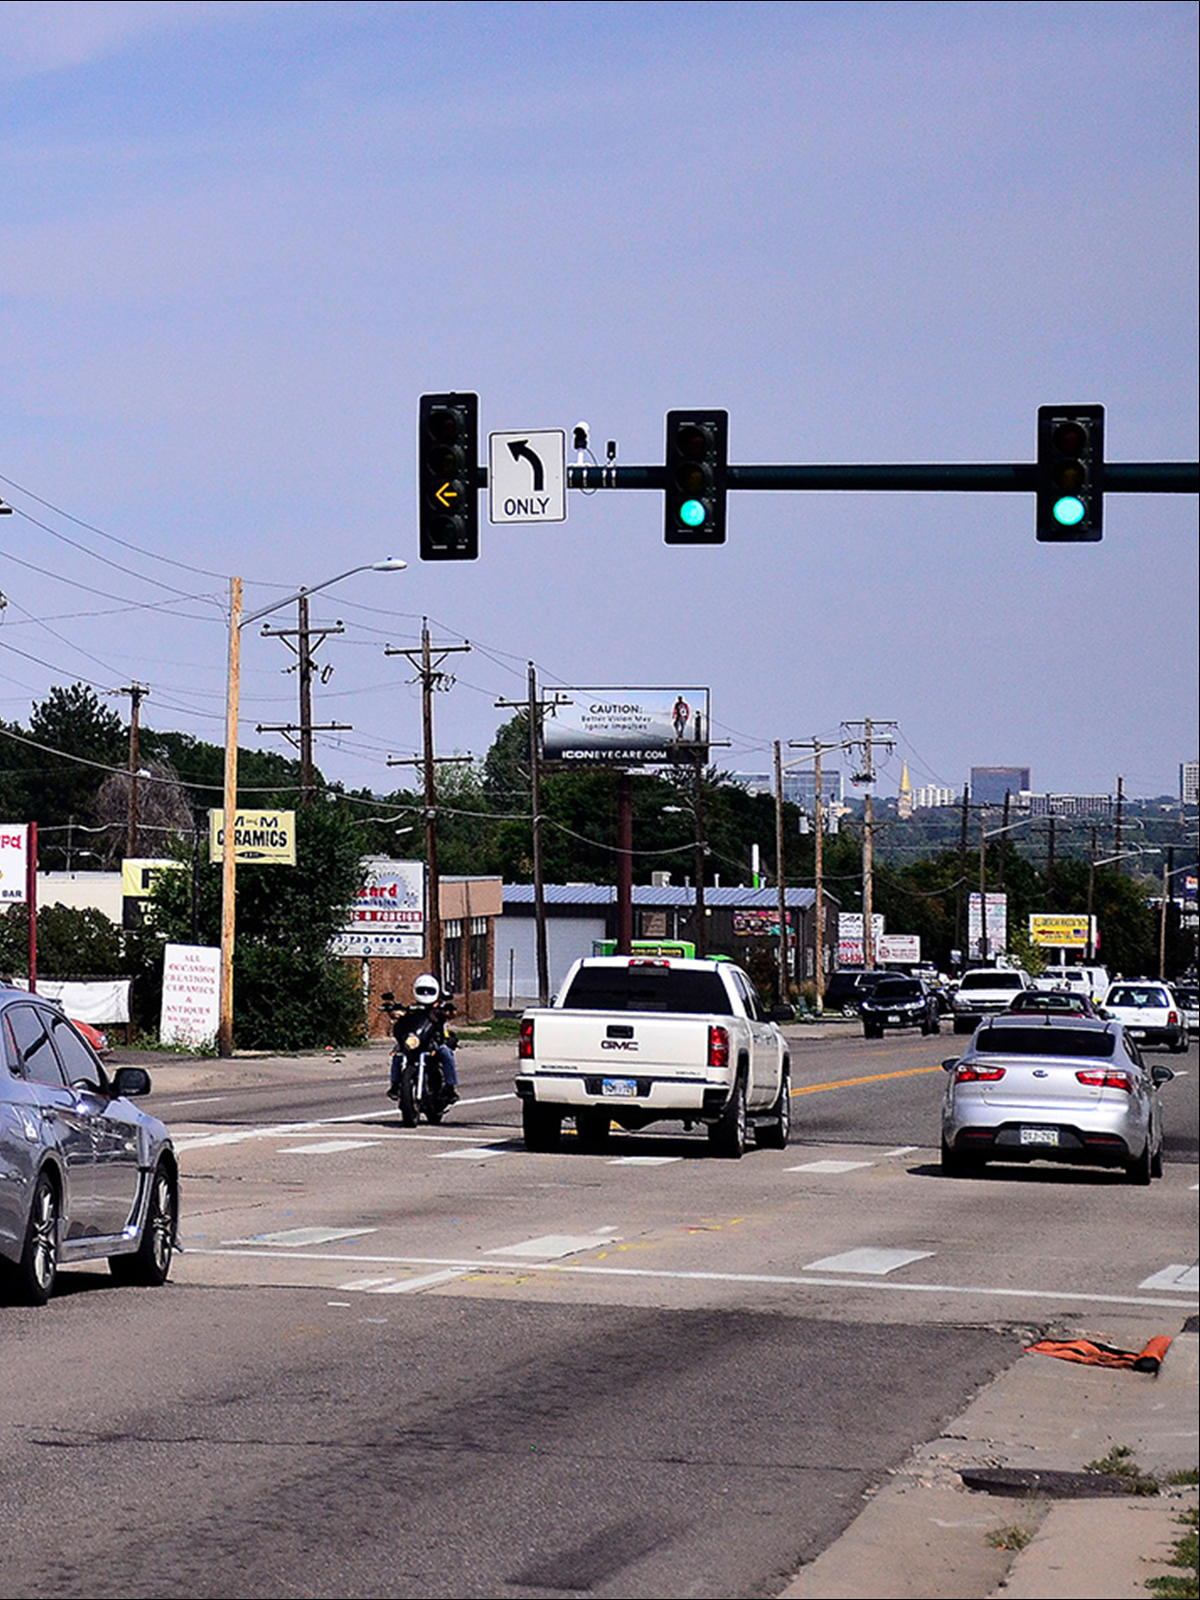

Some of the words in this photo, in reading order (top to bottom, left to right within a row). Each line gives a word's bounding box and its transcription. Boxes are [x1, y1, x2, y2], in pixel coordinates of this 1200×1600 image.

[504, 498, 550, 515] ONLY
[589, 704, 643, 714] CAUTION:
[562, 750, 667, 759] ICONEYECARE.COM
[260, 816, 279, 827] M
[217, 830, 288, 847] CRAMICS
[2, 890, 22, 898] BAR
[166, 984, 215, 995] CERAMICS
[601, 1040, 638, 1051] GMC
